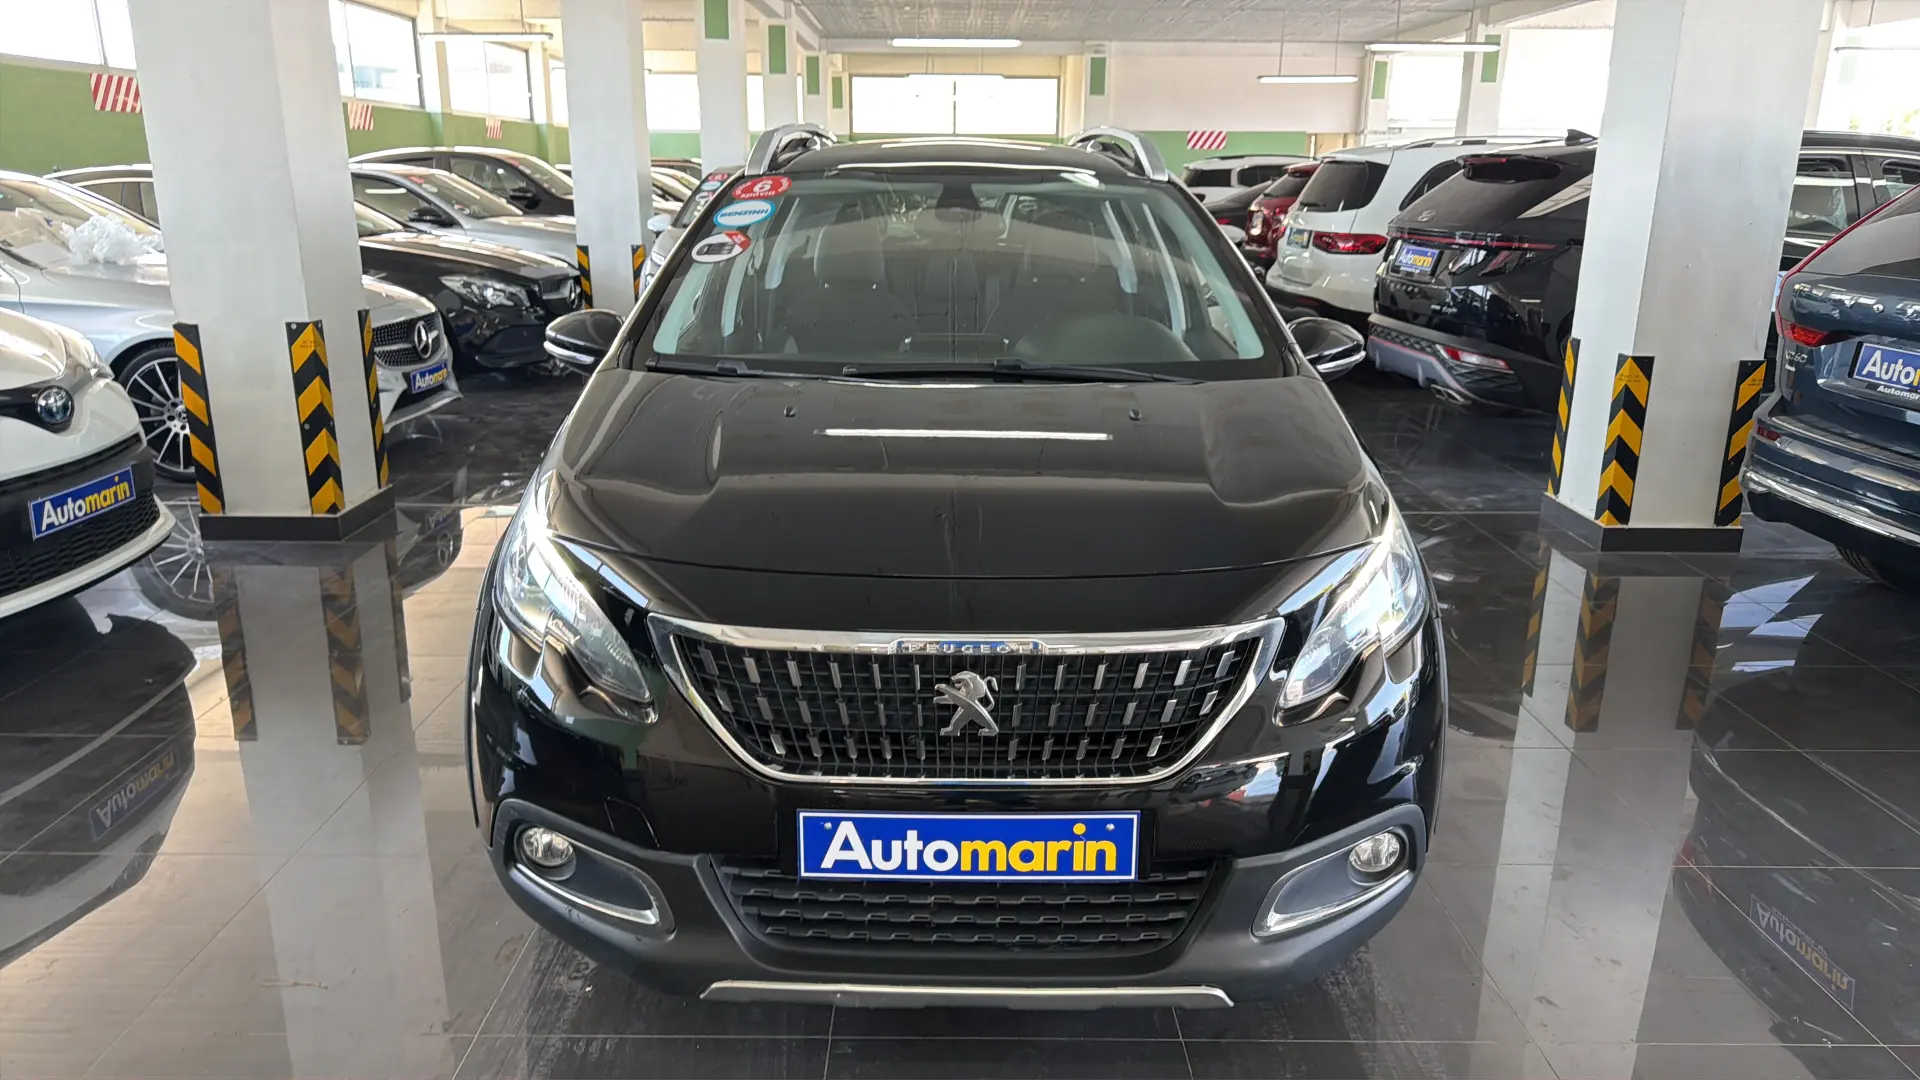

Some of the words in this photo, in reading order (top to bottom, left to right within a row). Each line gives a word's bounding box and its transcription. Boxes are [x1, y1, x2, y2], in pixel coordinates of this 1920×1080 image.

[753, 179, 773, 193] 6
[41, 475, 131, 532] Automarin
[820, 820, 1117, 872] Automarin
